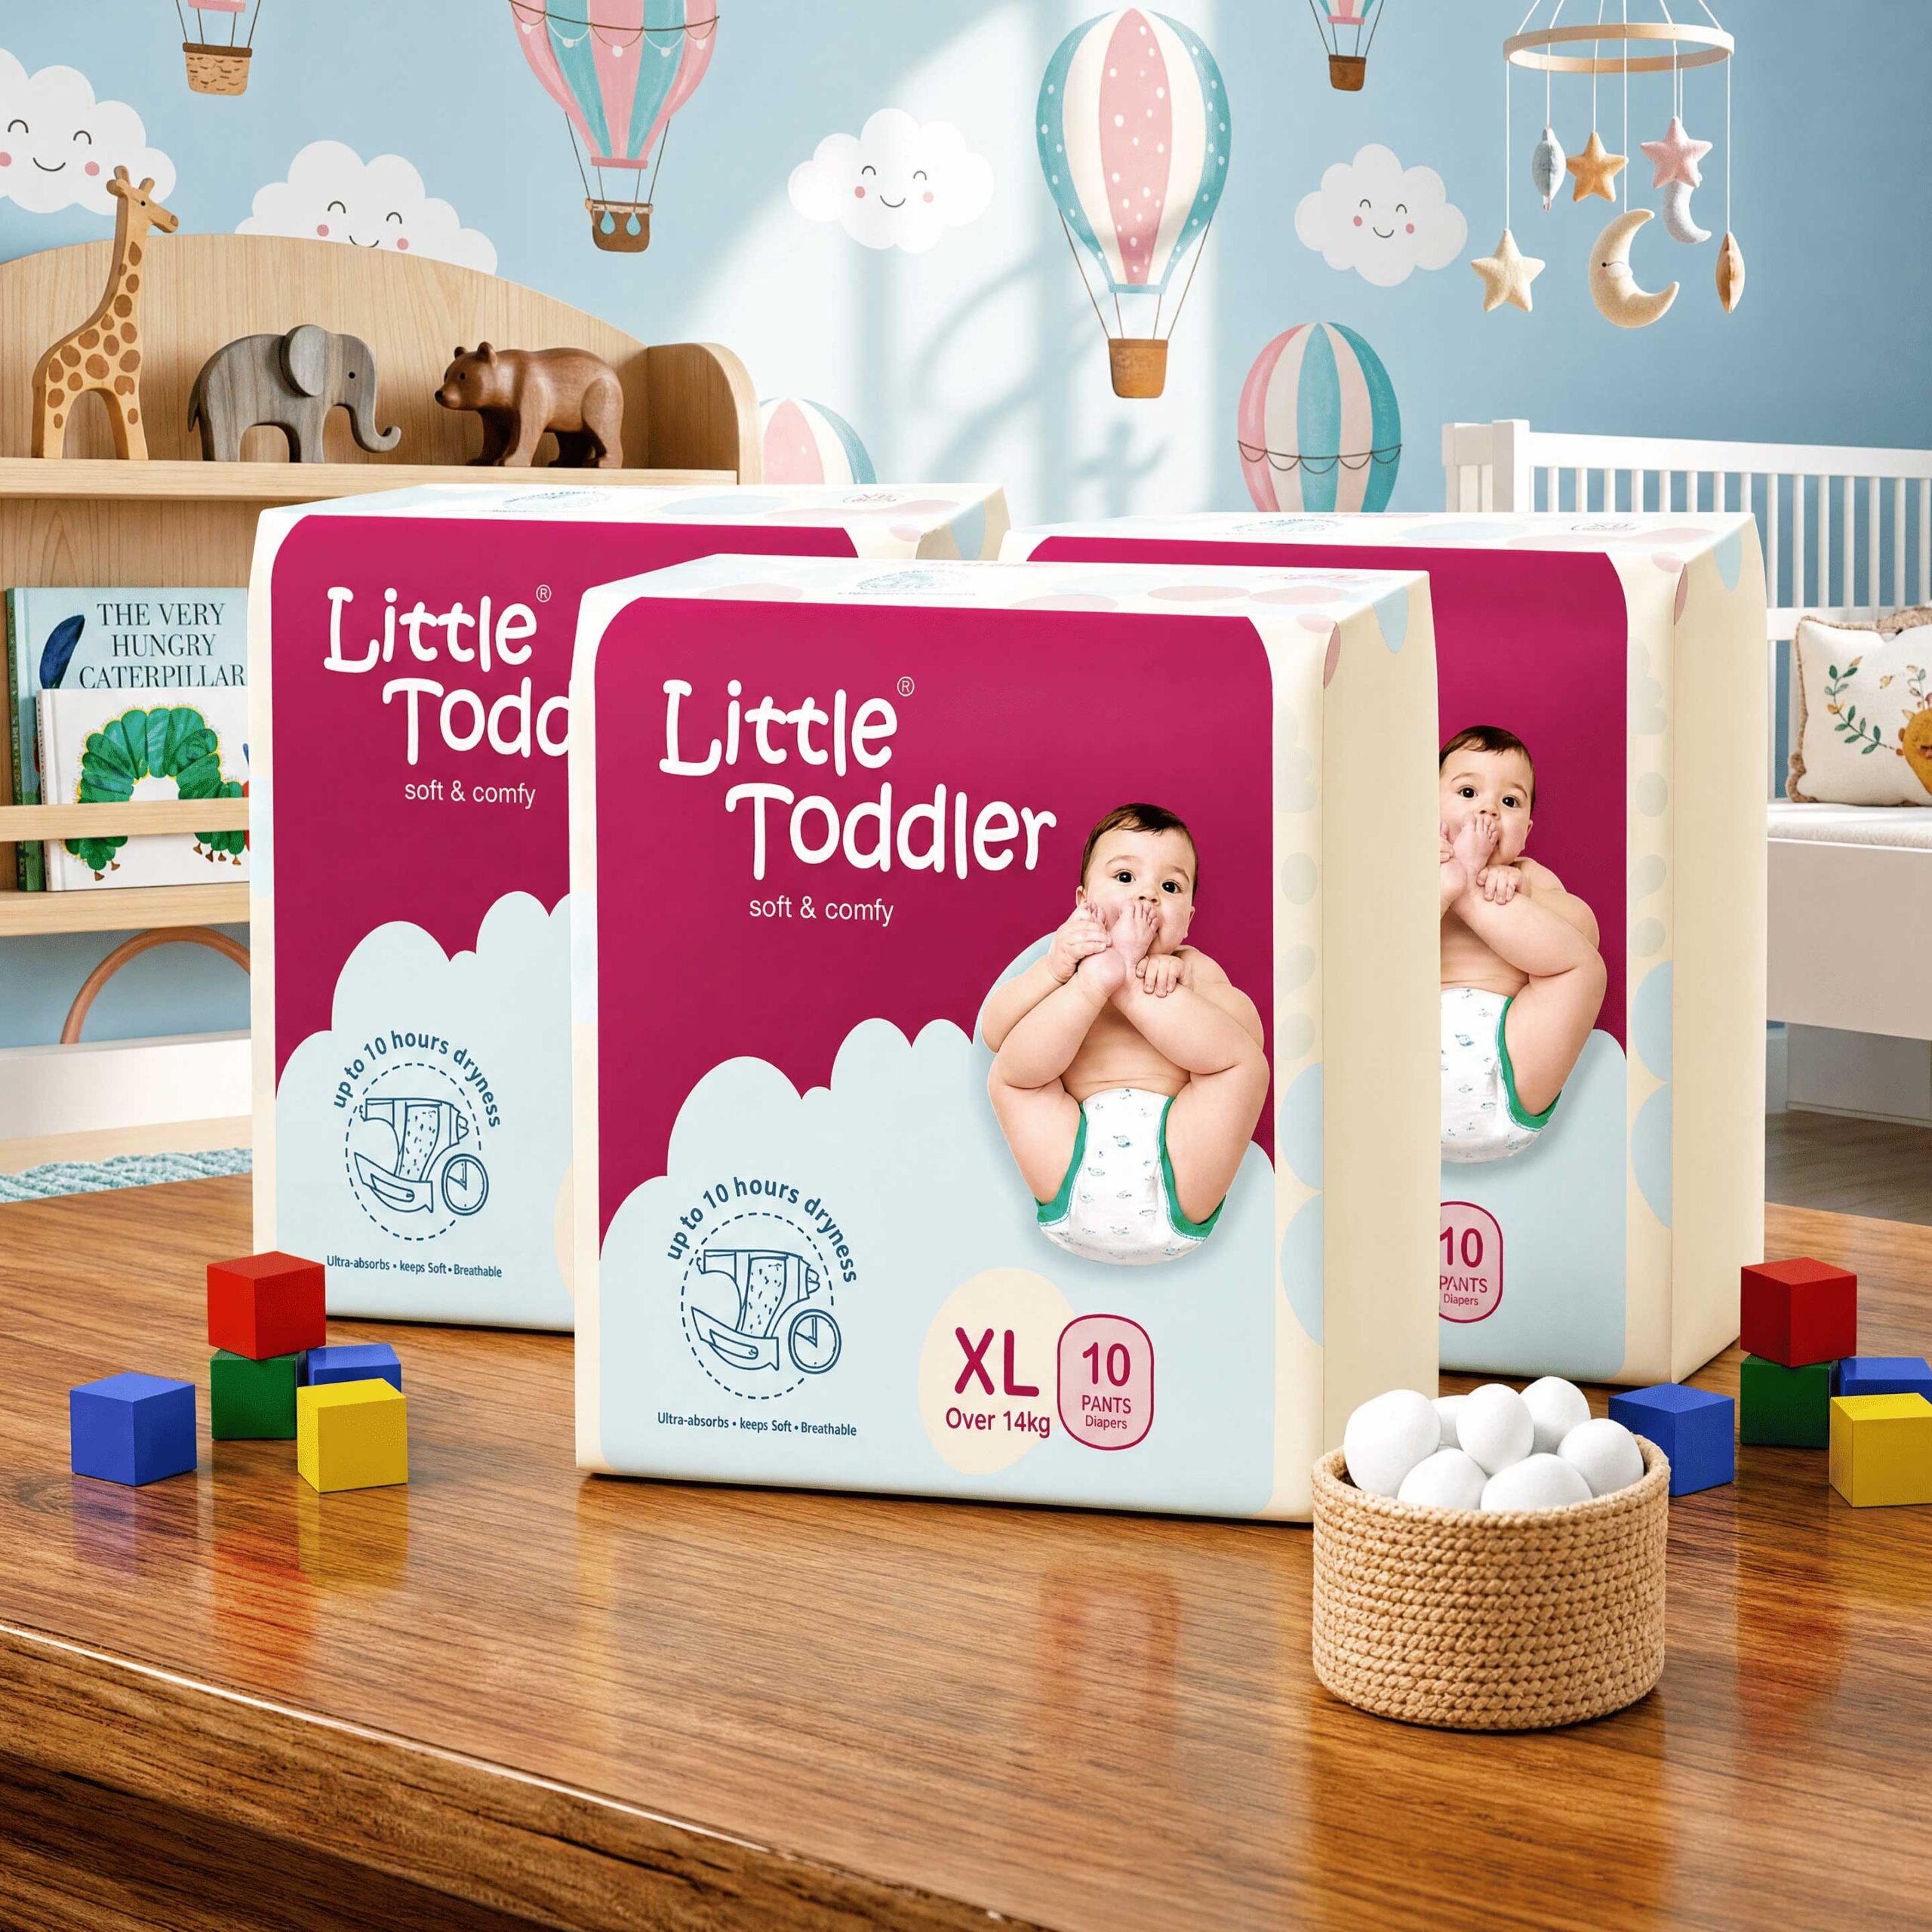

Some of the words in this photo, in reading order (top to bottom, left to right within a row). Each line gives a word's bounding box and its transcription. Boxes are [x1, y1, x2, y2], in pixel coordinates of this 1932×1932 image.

[96, 603, 151, 626] THE
[157, 602, 226, 626] VERY
[323, 586, 537, 672] Little
[111, 633, 217, 657] HUNGRY
[78, 664, 247, 689] CATERPILLAR
[659, 679, 898, 777] Little
[405, 780, 444, 801] soft
[451, 780, 466, 802] &
[472, 782, 536, 810] comfy
[724, 781, 1057, 881] Toddler
[749, 895, 792, 918] soft
[799, 895, 817, 919] &
[825, 898, 894, 928] comfy
[363, 1037, 387, 1061] 10
[390, 1030, 449, 1055] hours
[343, 1058, 365, 1081] to
[334, 1081, 354, 1109] up
[453, 1048, 501, 1128] dryness
[667, 1232, 691, 1260] up
[679, 1208, 703, 1230] to
[703, 1183, 729, 1209] 10
[733, 1176, 800, 1204] hours
[804, 1198, 857, 1283] dryness
[1440, 1226, 1484, 1269] 10
[327, 1255, 390, 1271] Ultra-absorbs
[399, 1260, 426, 1275] keeps
[427, 1262, 447, 1275] Soft
[454, 1263, 503, 1278] Breathable
[1440, 1275, 1488, 1294] PANTS
[1443, 1293, 1479, 1307] Diapers
[954, 1327, 1040, 1398] XL
[1082, 1342, 1131, 1387] 10
[1081, 1395, 1132, 1414] PANTS
[657, 1411, 730, 1429] Ultra-absorbs
[740, 1417, 768, 1434] keeps
[771, 1420, 792, 1432] Soft
[801, 1421, 857, 1436] Breathable
[946, 1407, 996, 1431] Over
[1003, 1410, 1051, 1439] 14kg
[1085, 1414, 1128, 1431] Diapers
